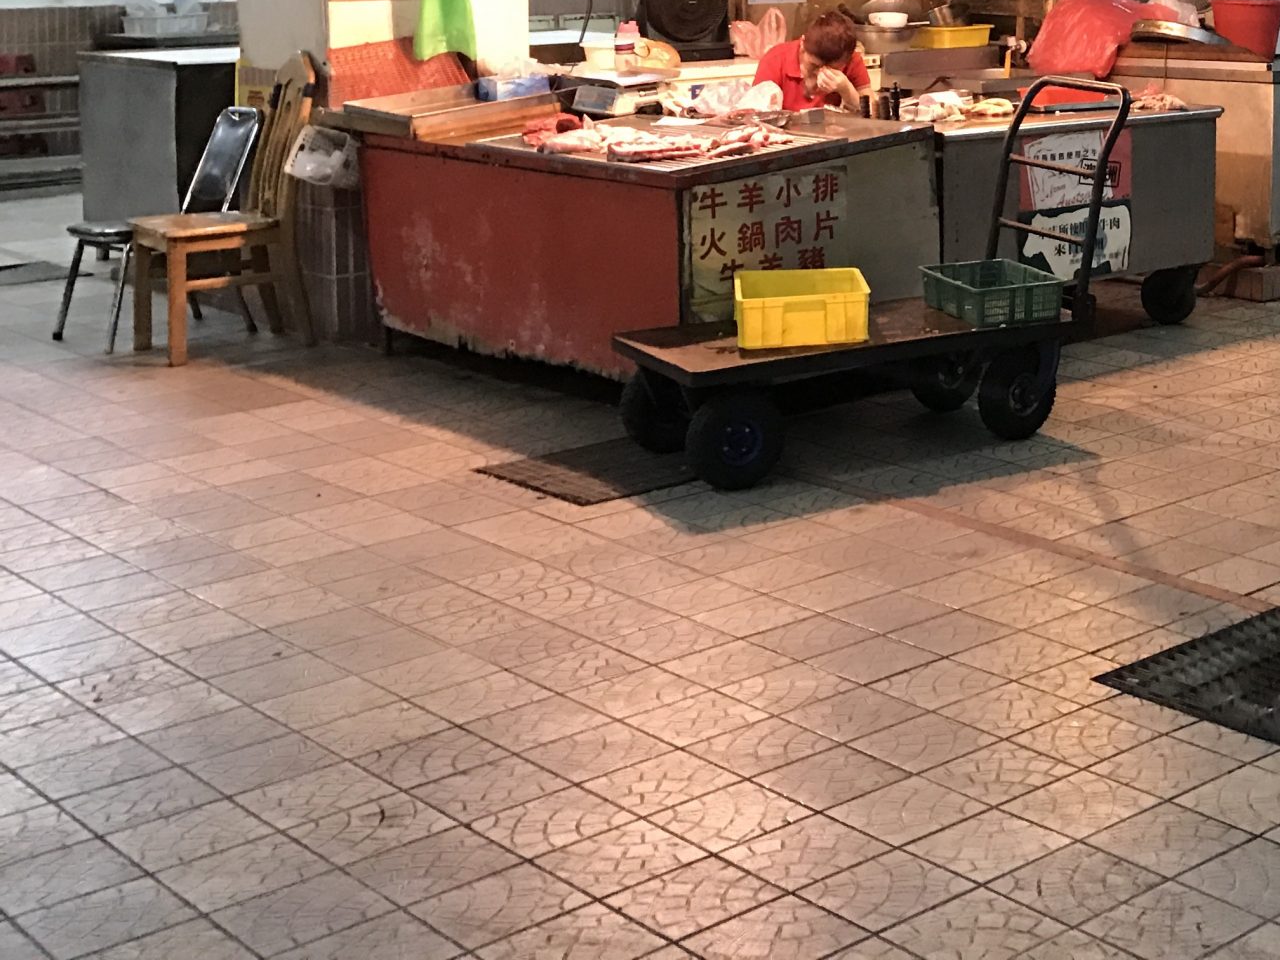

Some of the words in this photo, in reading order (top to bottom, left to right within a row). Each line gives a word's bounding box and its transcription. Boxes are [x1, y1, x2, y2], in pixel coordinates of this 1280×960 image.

[698, 173, 840, 220] 牛羊小排
[699, 209, 840, 261] 火鍋肉片
